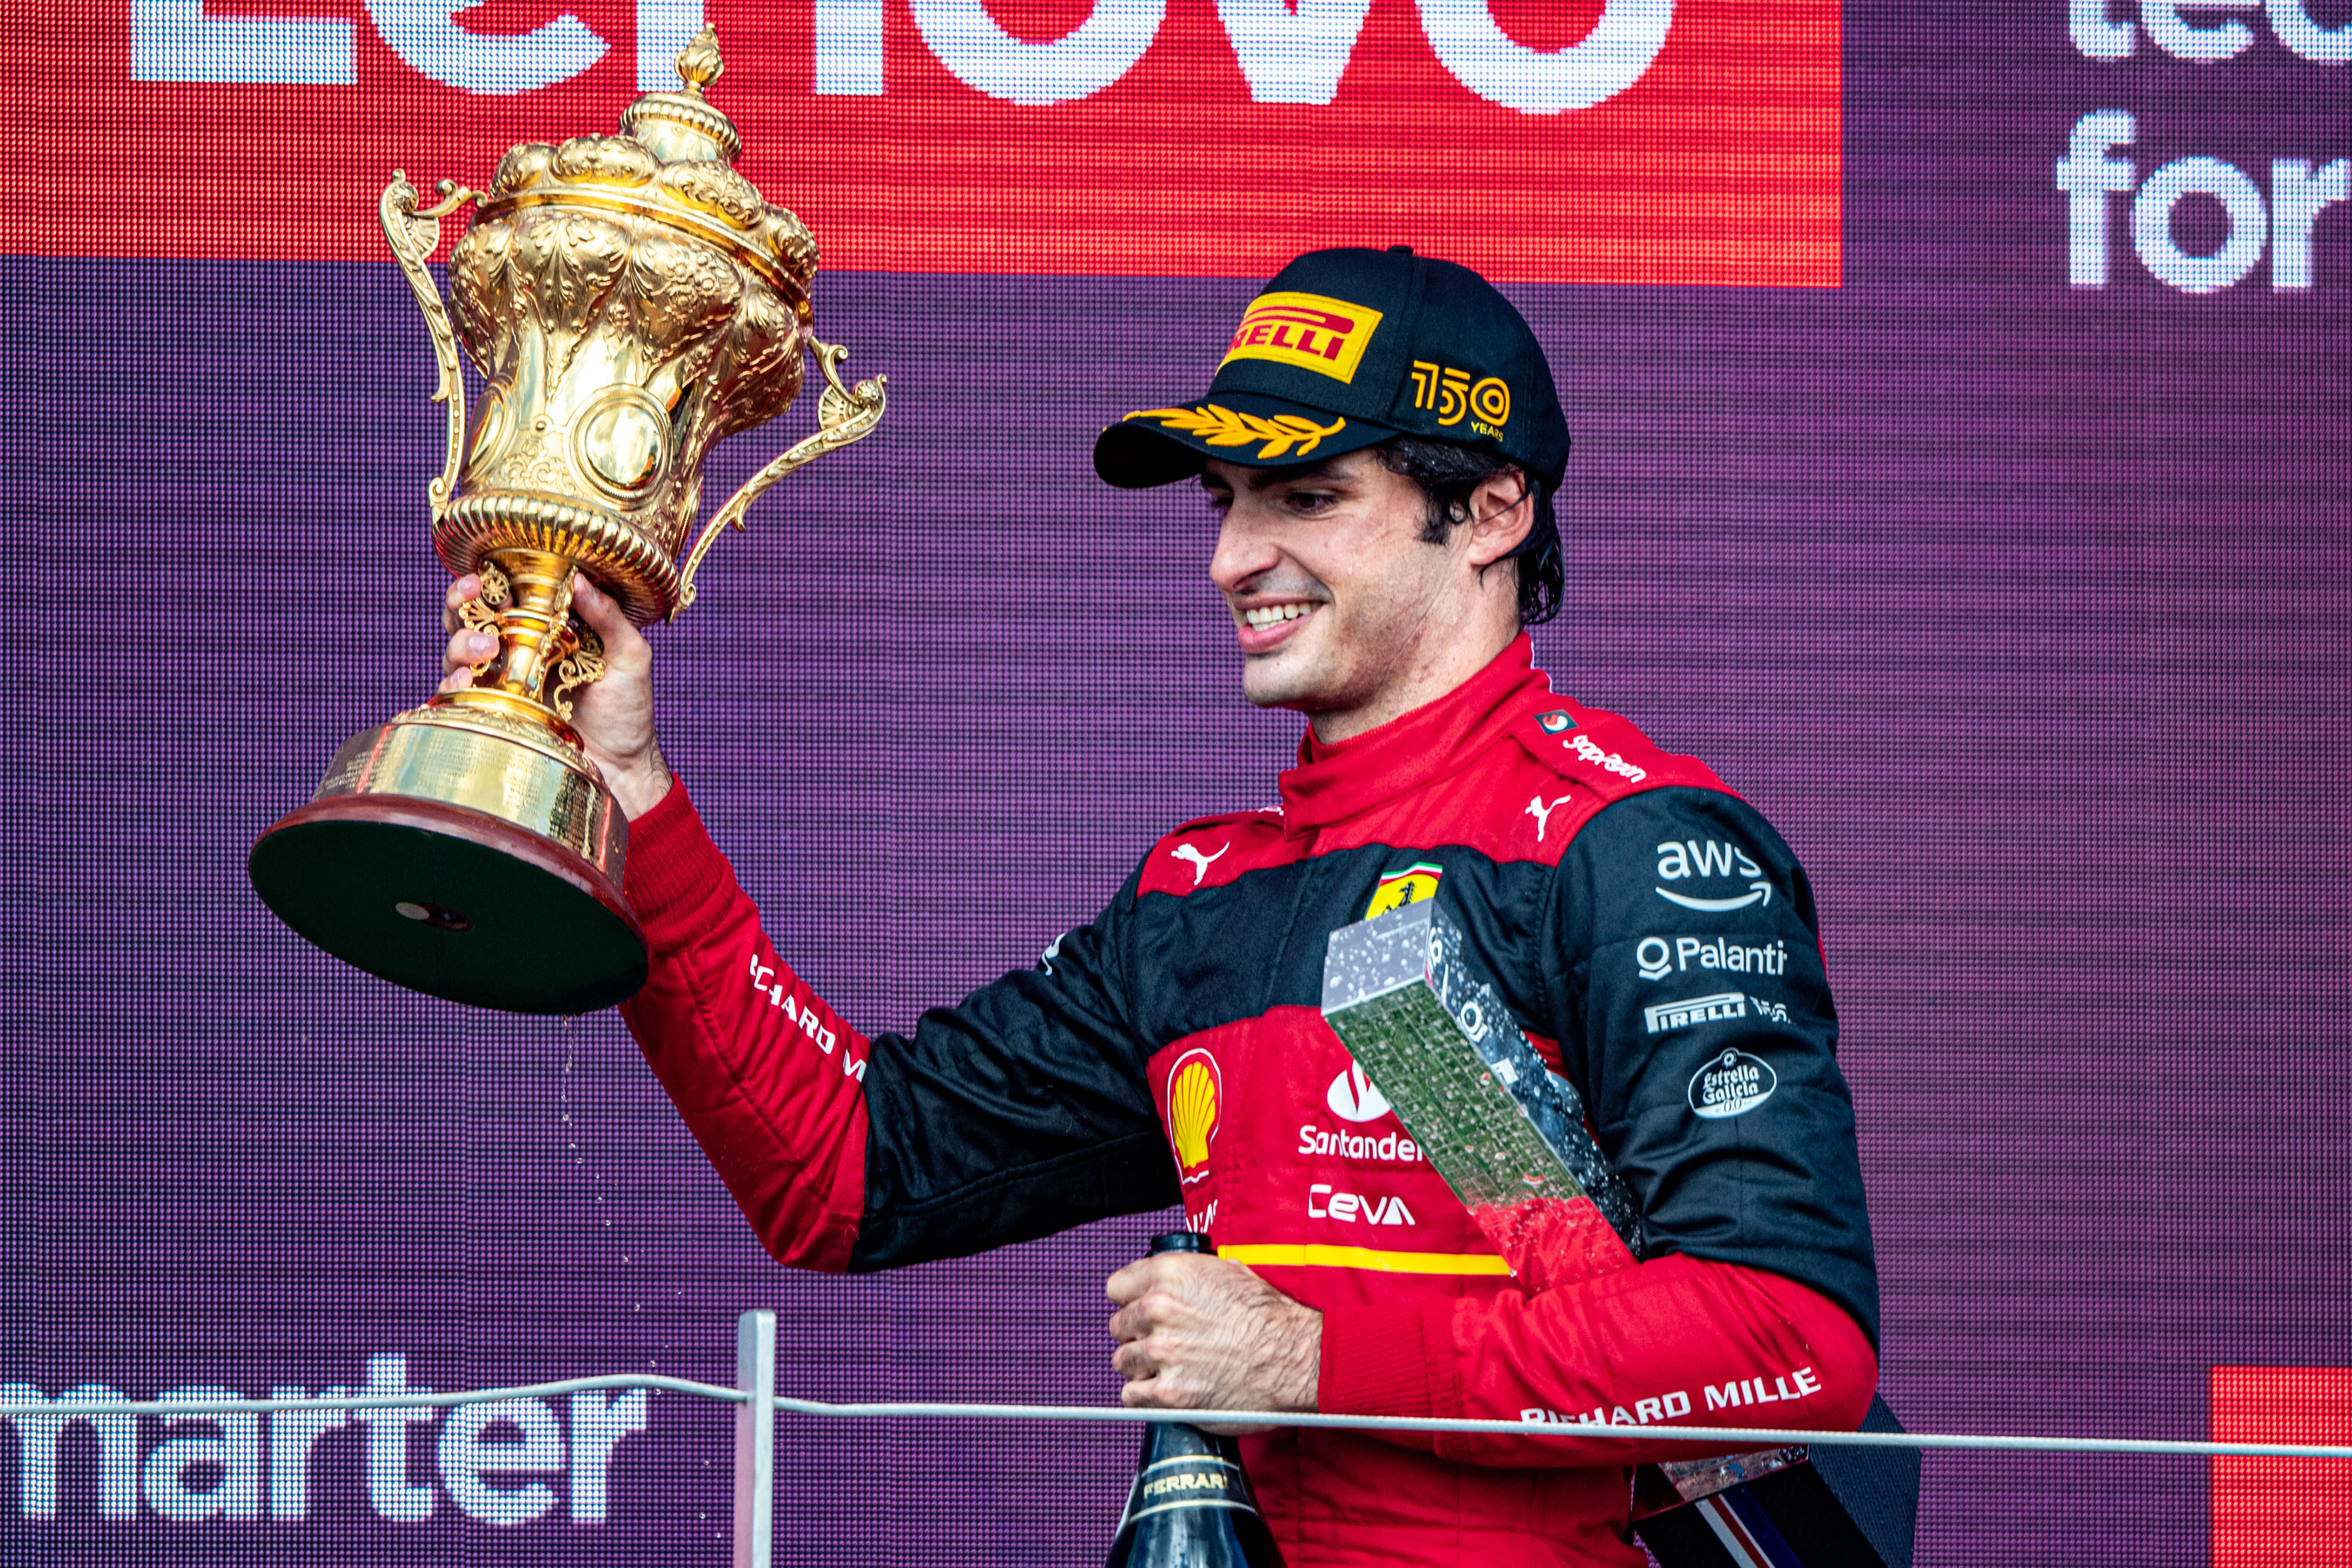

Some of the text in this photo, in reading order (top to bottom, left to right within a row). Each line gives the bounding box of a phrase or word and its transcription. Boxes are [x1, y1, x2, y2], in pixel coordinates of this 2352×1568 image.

[2056, 109, 2352, 294] for
[1411, 360, 1510, 427] 150
[1471, 421, 1504, 443] YEARS
[1676, 937, 1788, 977] Palanti
[1644, 992, 1746, 1034] PIRELLI
[1702, 1081, 1759, 1106] Galicia
[1703, 1064, 1760, 1091] Estrella
[1704, 1366, 1822, 1411] MILLE
